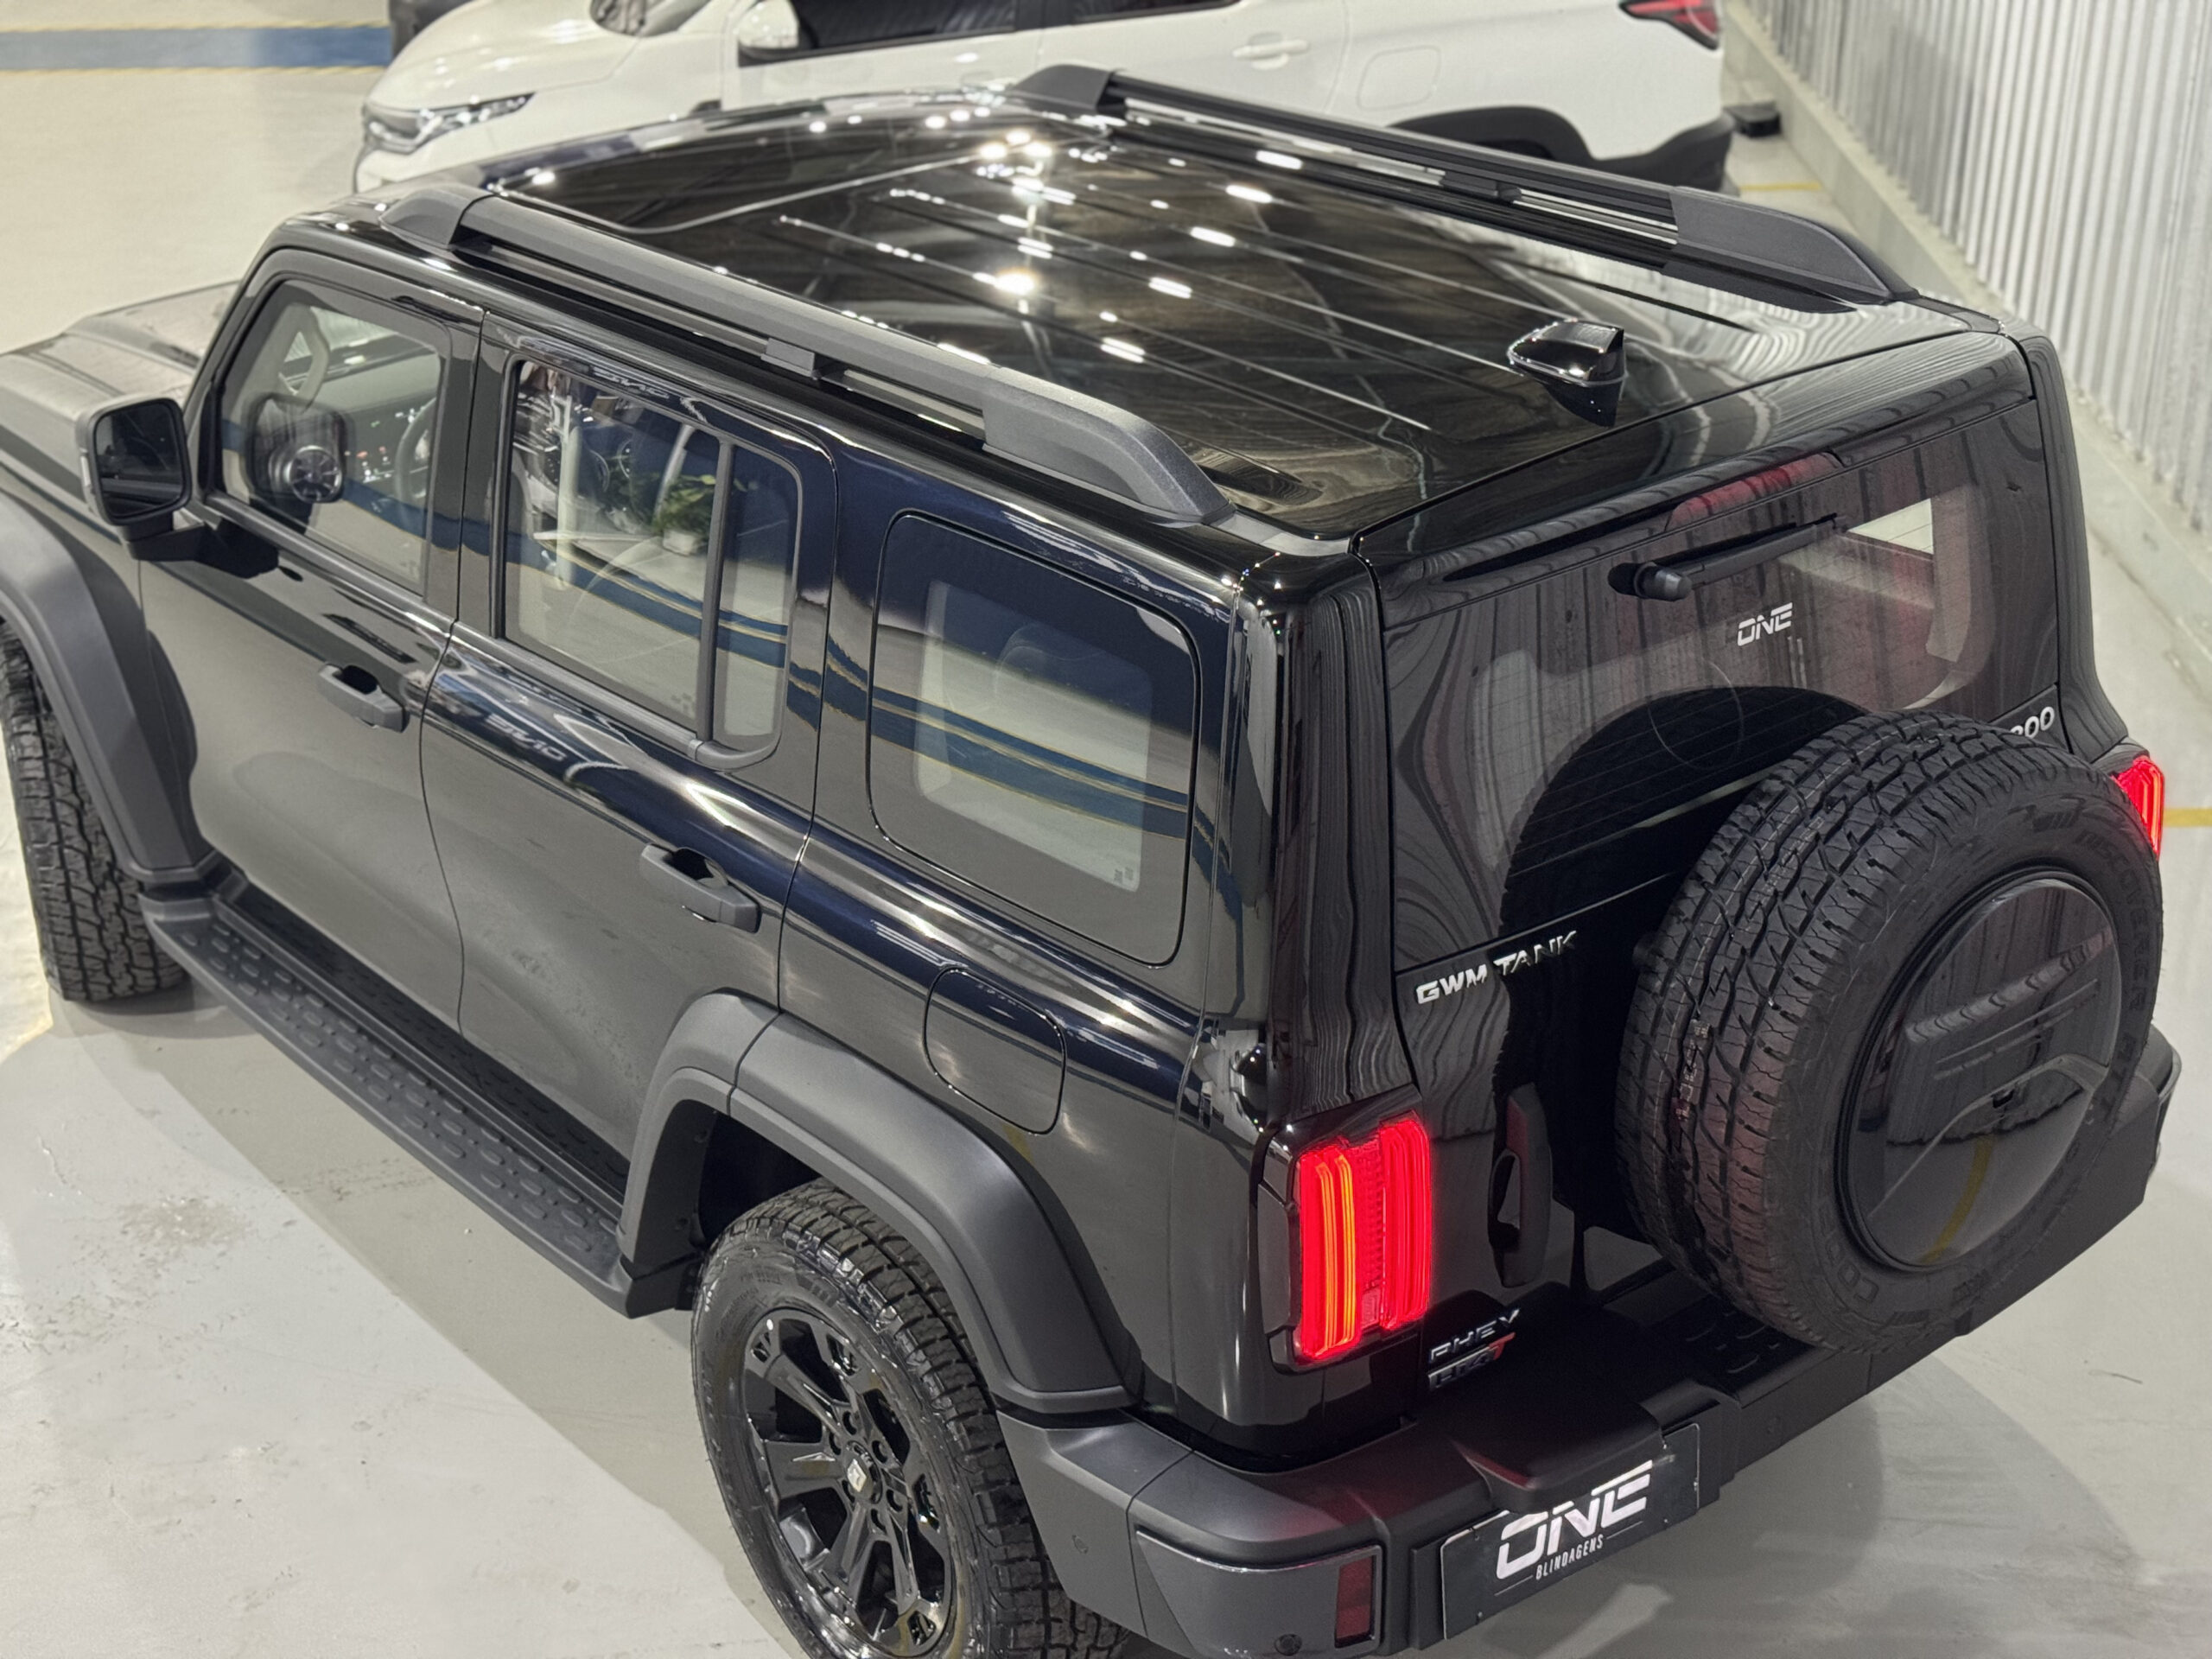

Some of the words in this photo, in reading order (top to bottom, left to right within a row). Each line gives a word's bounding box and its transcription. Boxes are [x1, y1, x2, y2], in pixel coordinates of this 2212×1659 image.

[1737, 602, 1793, 646] ONE
[1415, 964, 1487, 1004] GWM
[1493, 930, 1577, 976] TANK
[1428, 1307, 1521, 1363] PHEV
[1496, 1459, 1653, 1580] ONE
[1535, 1533, 1605, 1580] BLINDAGENS
